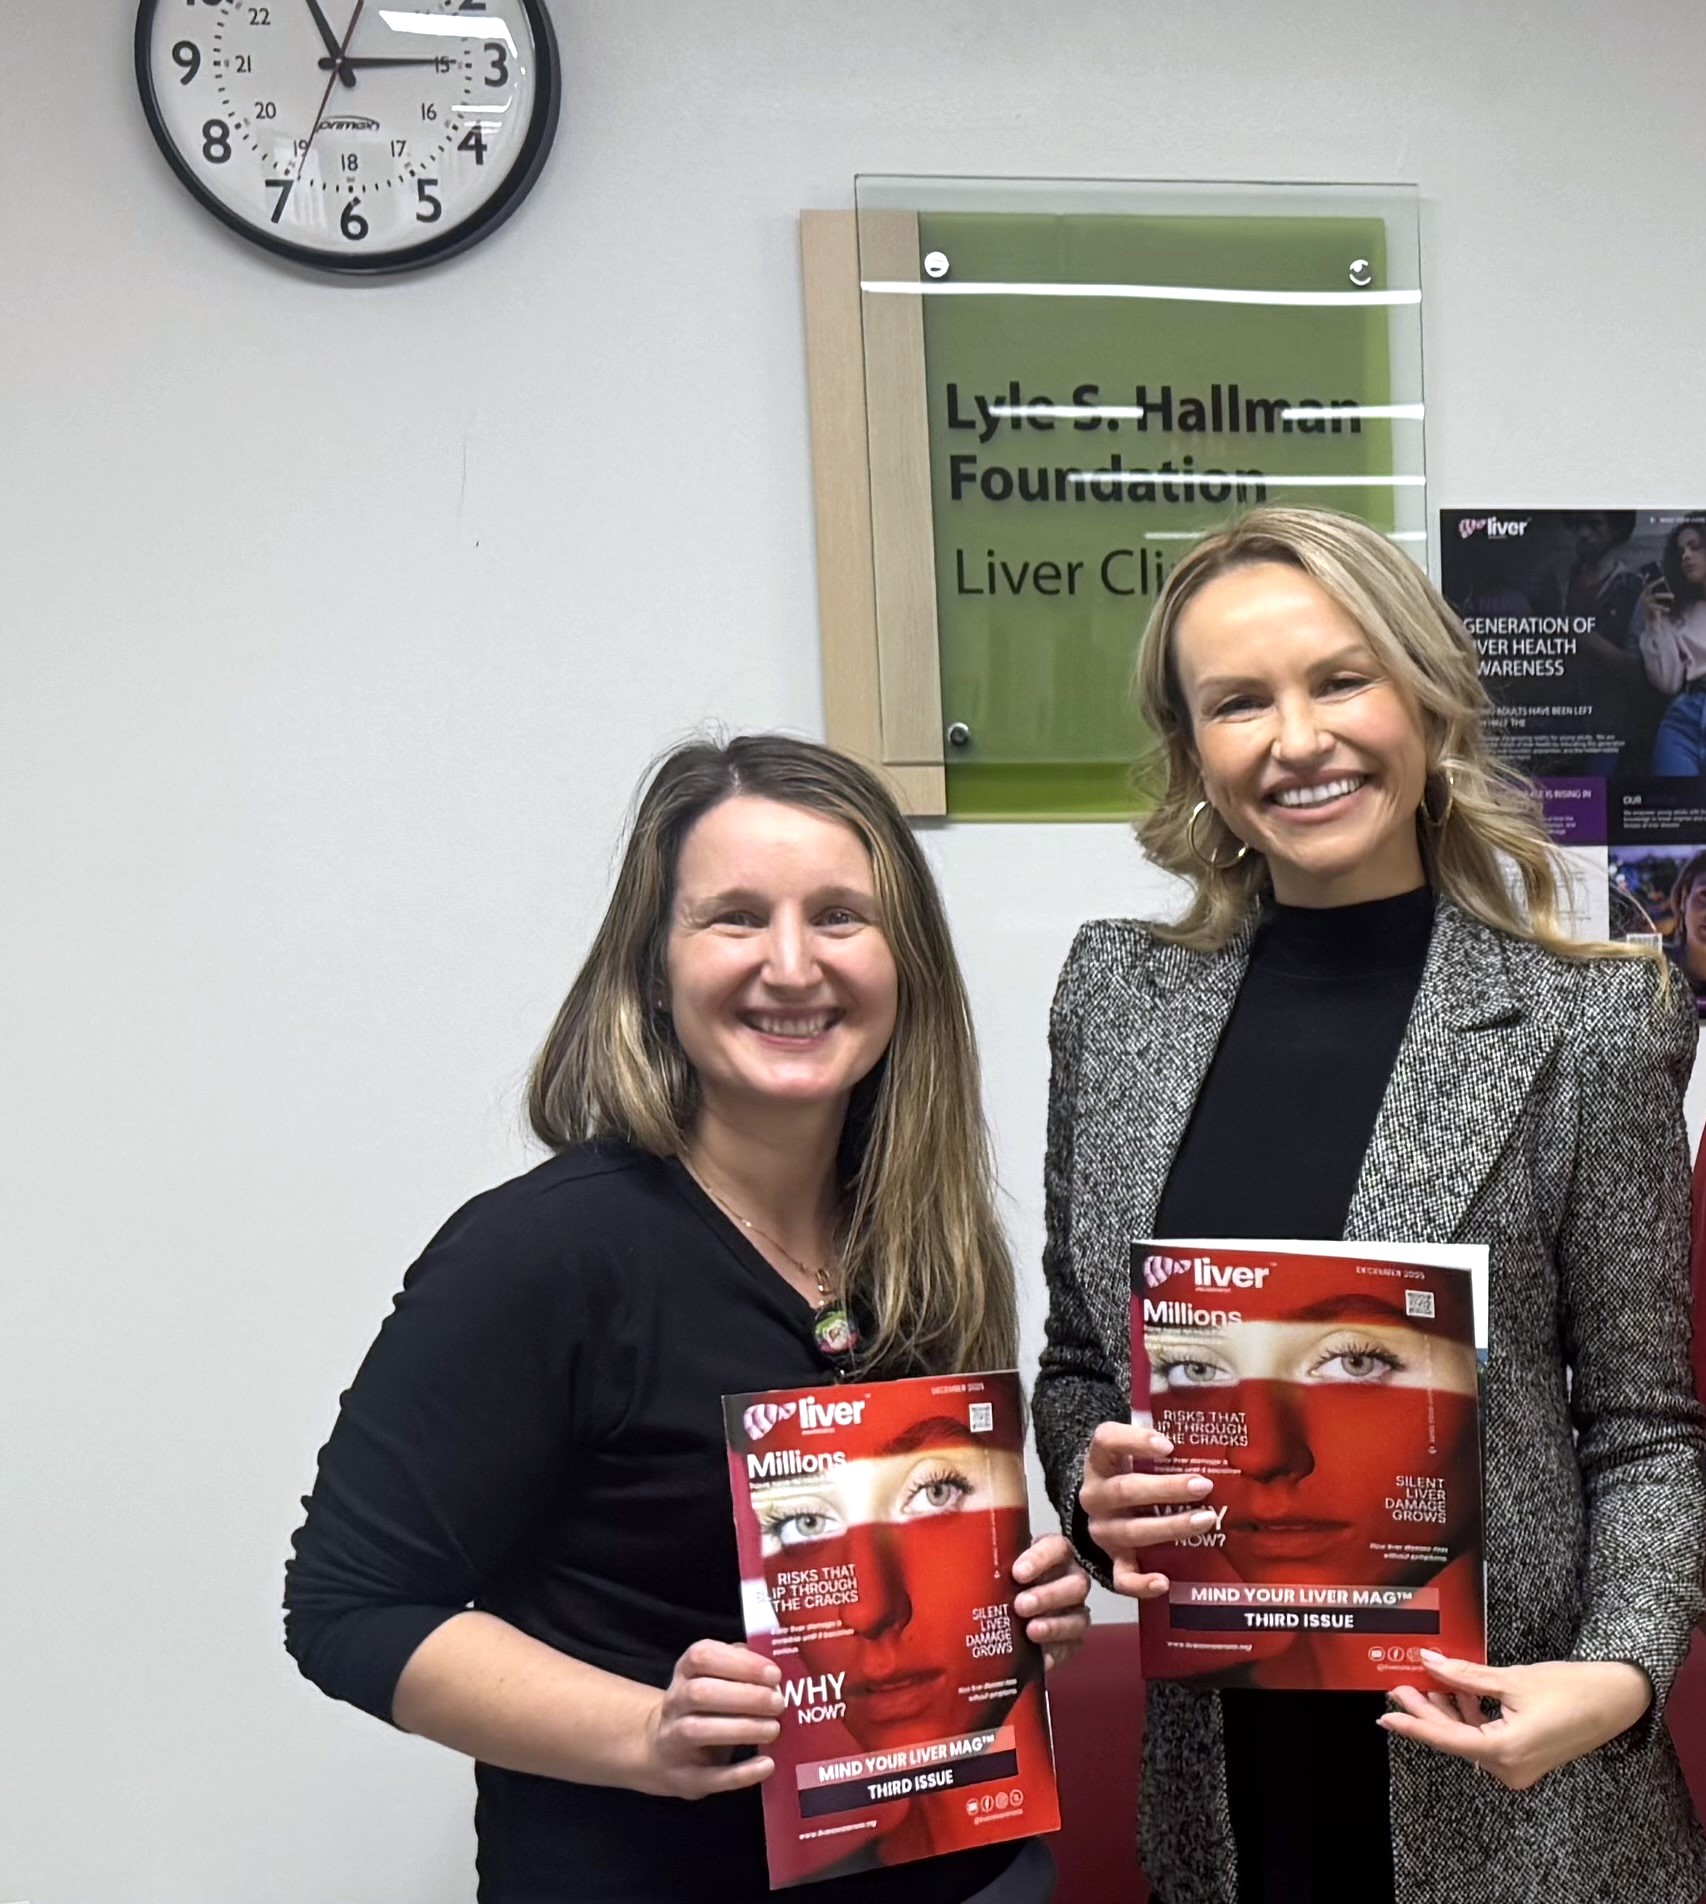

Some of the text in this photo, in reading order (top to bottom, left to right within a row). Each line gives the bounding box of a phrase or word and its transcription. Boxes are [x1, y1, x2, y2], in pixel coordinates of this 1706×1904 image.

[248, 8, 271, 26] 22
[171, 41, 201, 85] 9
[235, 56, 252, 73] 21
[483, 42, 509, 87] 3
[255, 102, 277, 119] 20
[421, 103, 437, 120] 16
[202, 119, 232, 164] 8
[391, 140, 406, 157] 17
[457, 121, 488, 165] 4
[341, 153, 358, 171] 18
[265, 179, 294, 223] 7
[415, 179, 442, 223] 5
[340, 196, 369, 240] 6
[946, 381, 1362, 442] Lyle S. Hallman
[950, 454, 1266, 503] Foundation
[1487, 516, 1528, 537] liver
[955, 549, 1165, 597] Liver Cli
[1463, 617, 1596, 634] GENERATION OF
[1513, 638, 1577, 655] HEALTH
[1478, 659, 1565, 677] WARENESS
[1194, 1257, 1269, 1289] liver
[1144, 1298, 1242, 1326] Millions
[799, 1396, 865, 1428] liver
[1164, 1410, 1246, 1424] RISKS THAT
[1176, 1421, 1248, 1435] THROUGH
[1190, 1434, 1248, 1447] CRACKS
[747, 1449, 847, 1479] Millions
[1396, 1475, 1445, 1488] SILENT
[1406, 1488, 1446, 1500] LIVER
[1385, 1497, 1446, 1512] DAMAGE
[1392, 1509, 1446, 1524] GROWS
[778, 1564, 856, 1585] RISKS THAT
[790, 1577, 858, 1597] THROUGH
[1191, 1588, 1240, 1602] MIND
[1244, 1589, 1296, 1604] YOUR
[1300, 1590, 1348, 1604] LIVER
[772, 1590, 859, 1612] THE CRACKS
[972, 1604, 1008, 1620] SILENT
[1244, 1612, 1354, 1628] THIRD ISSUE
[981, 1616, 1011, 1632] LIVER
[966, 1629, 1012, 1647] DAMAGE
[972, 1641, 1013, 1658] GROWS
[777, 1671, 846, 1708] WHY
[798, 1702, 847, 1725] NOW?
[818, 1760, 863, 1782] MIND
[865, 1753, 907, 1773] YOUR
[909, 1744, 947, 1766] LIVER
[867, 1769, 954, 1800] THIRD ISSUE
